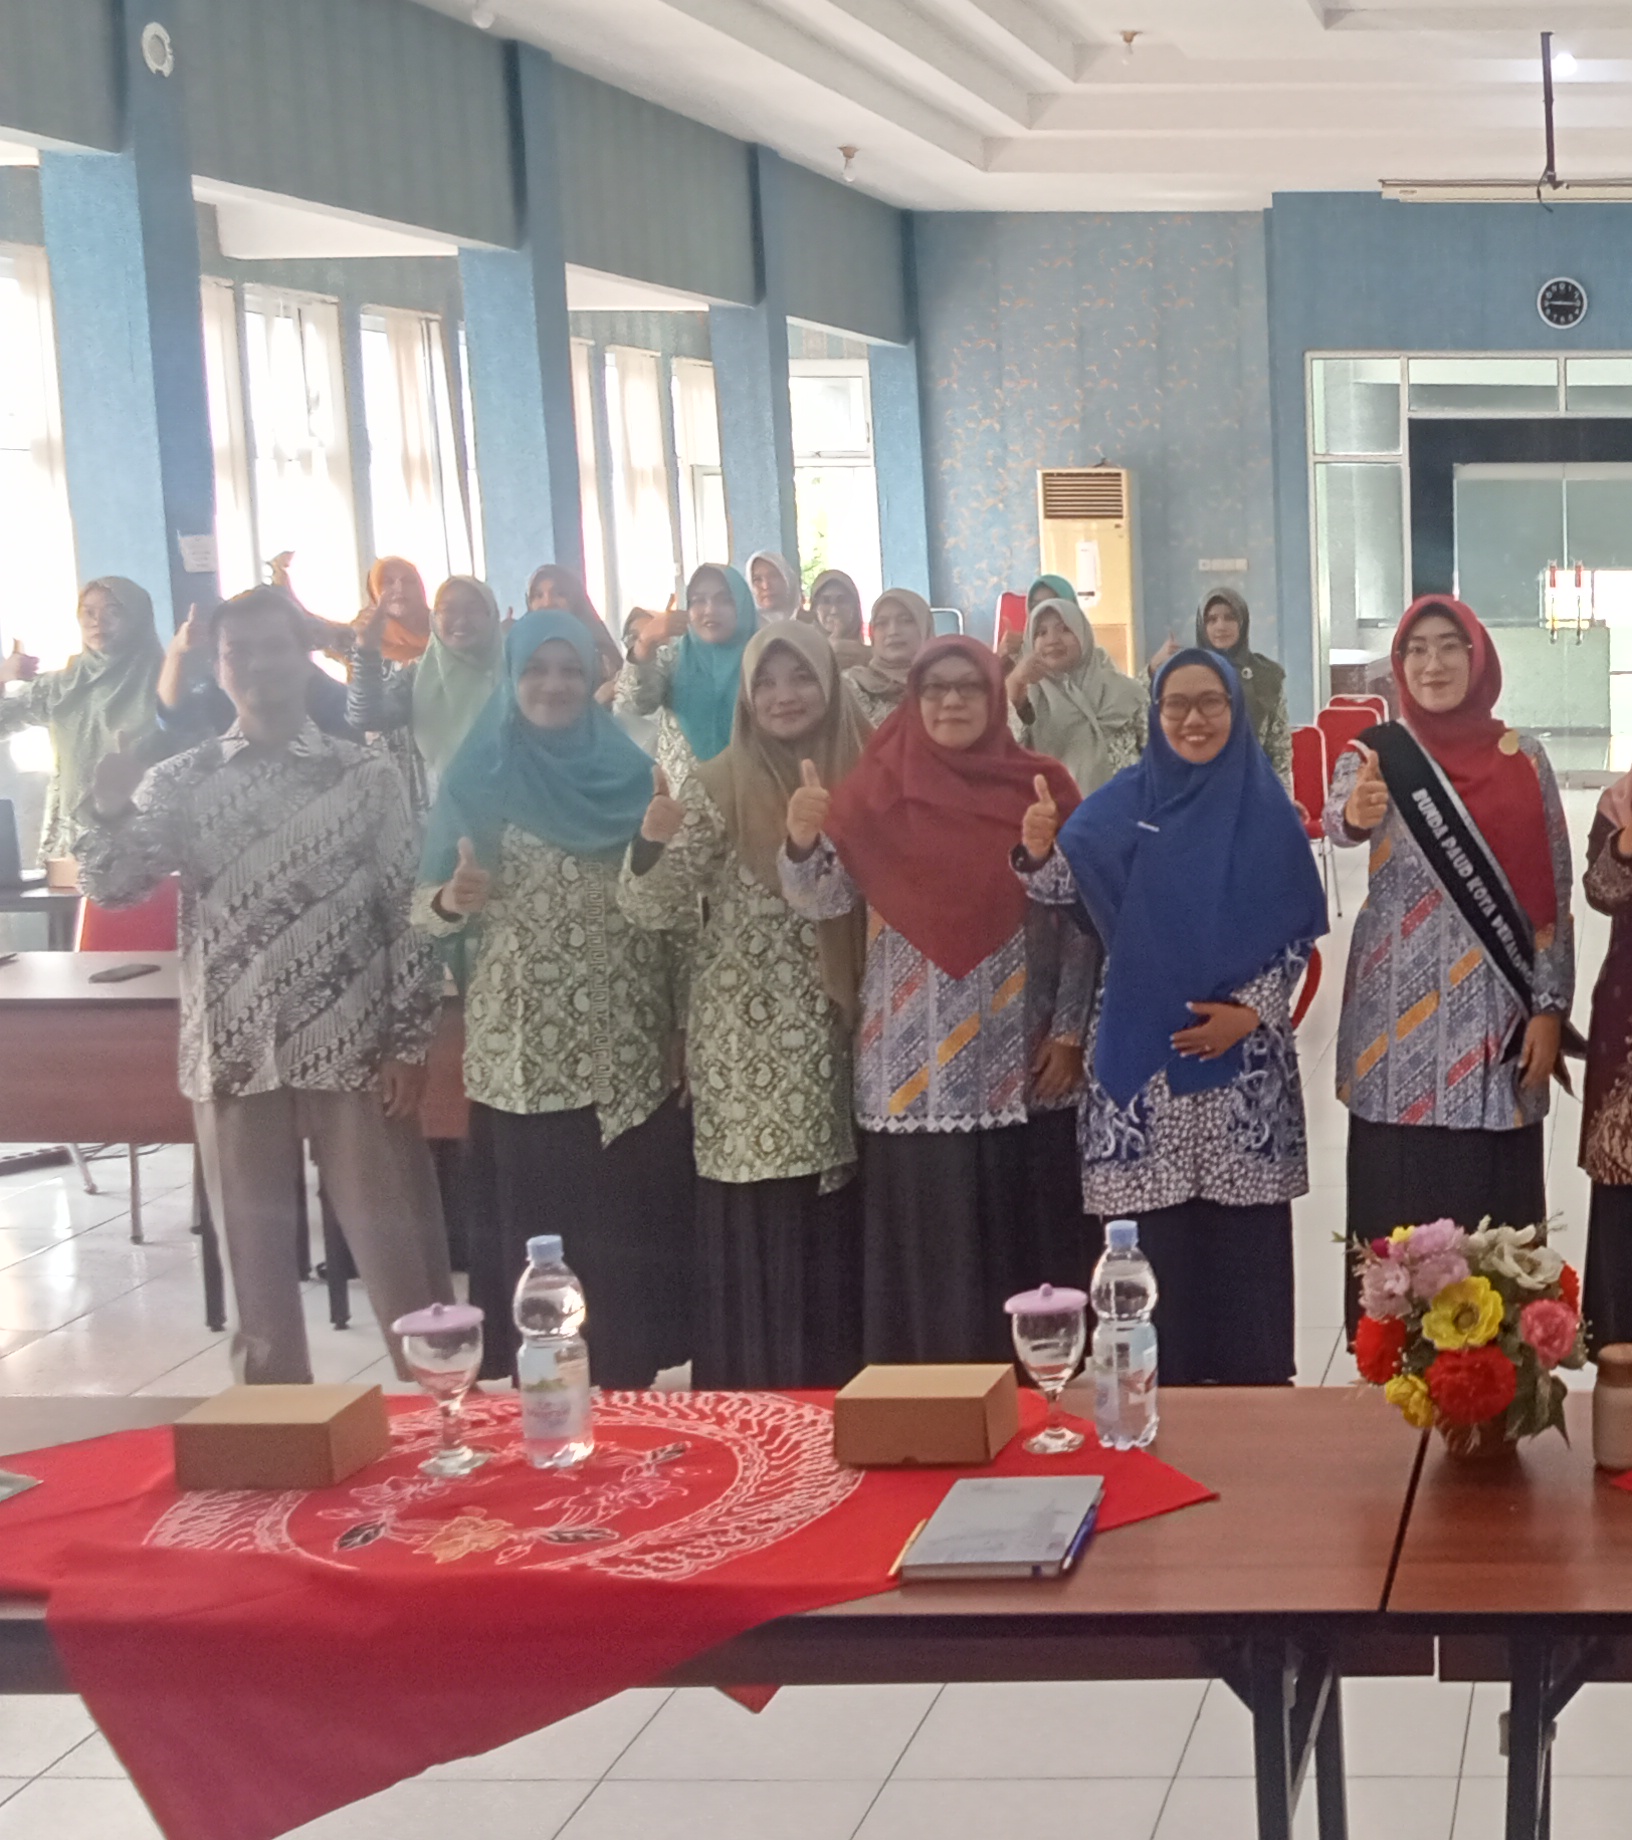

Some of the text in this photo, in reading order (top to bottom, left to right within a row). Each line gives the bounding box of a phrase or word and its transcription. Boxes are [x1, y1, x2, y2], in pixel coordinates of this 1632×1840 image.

[1411, 788, 1449, 840] BUNDA
[1441, 836, 1474, 878] PAUD
[1466, 876, 1497, 917] KOTA
